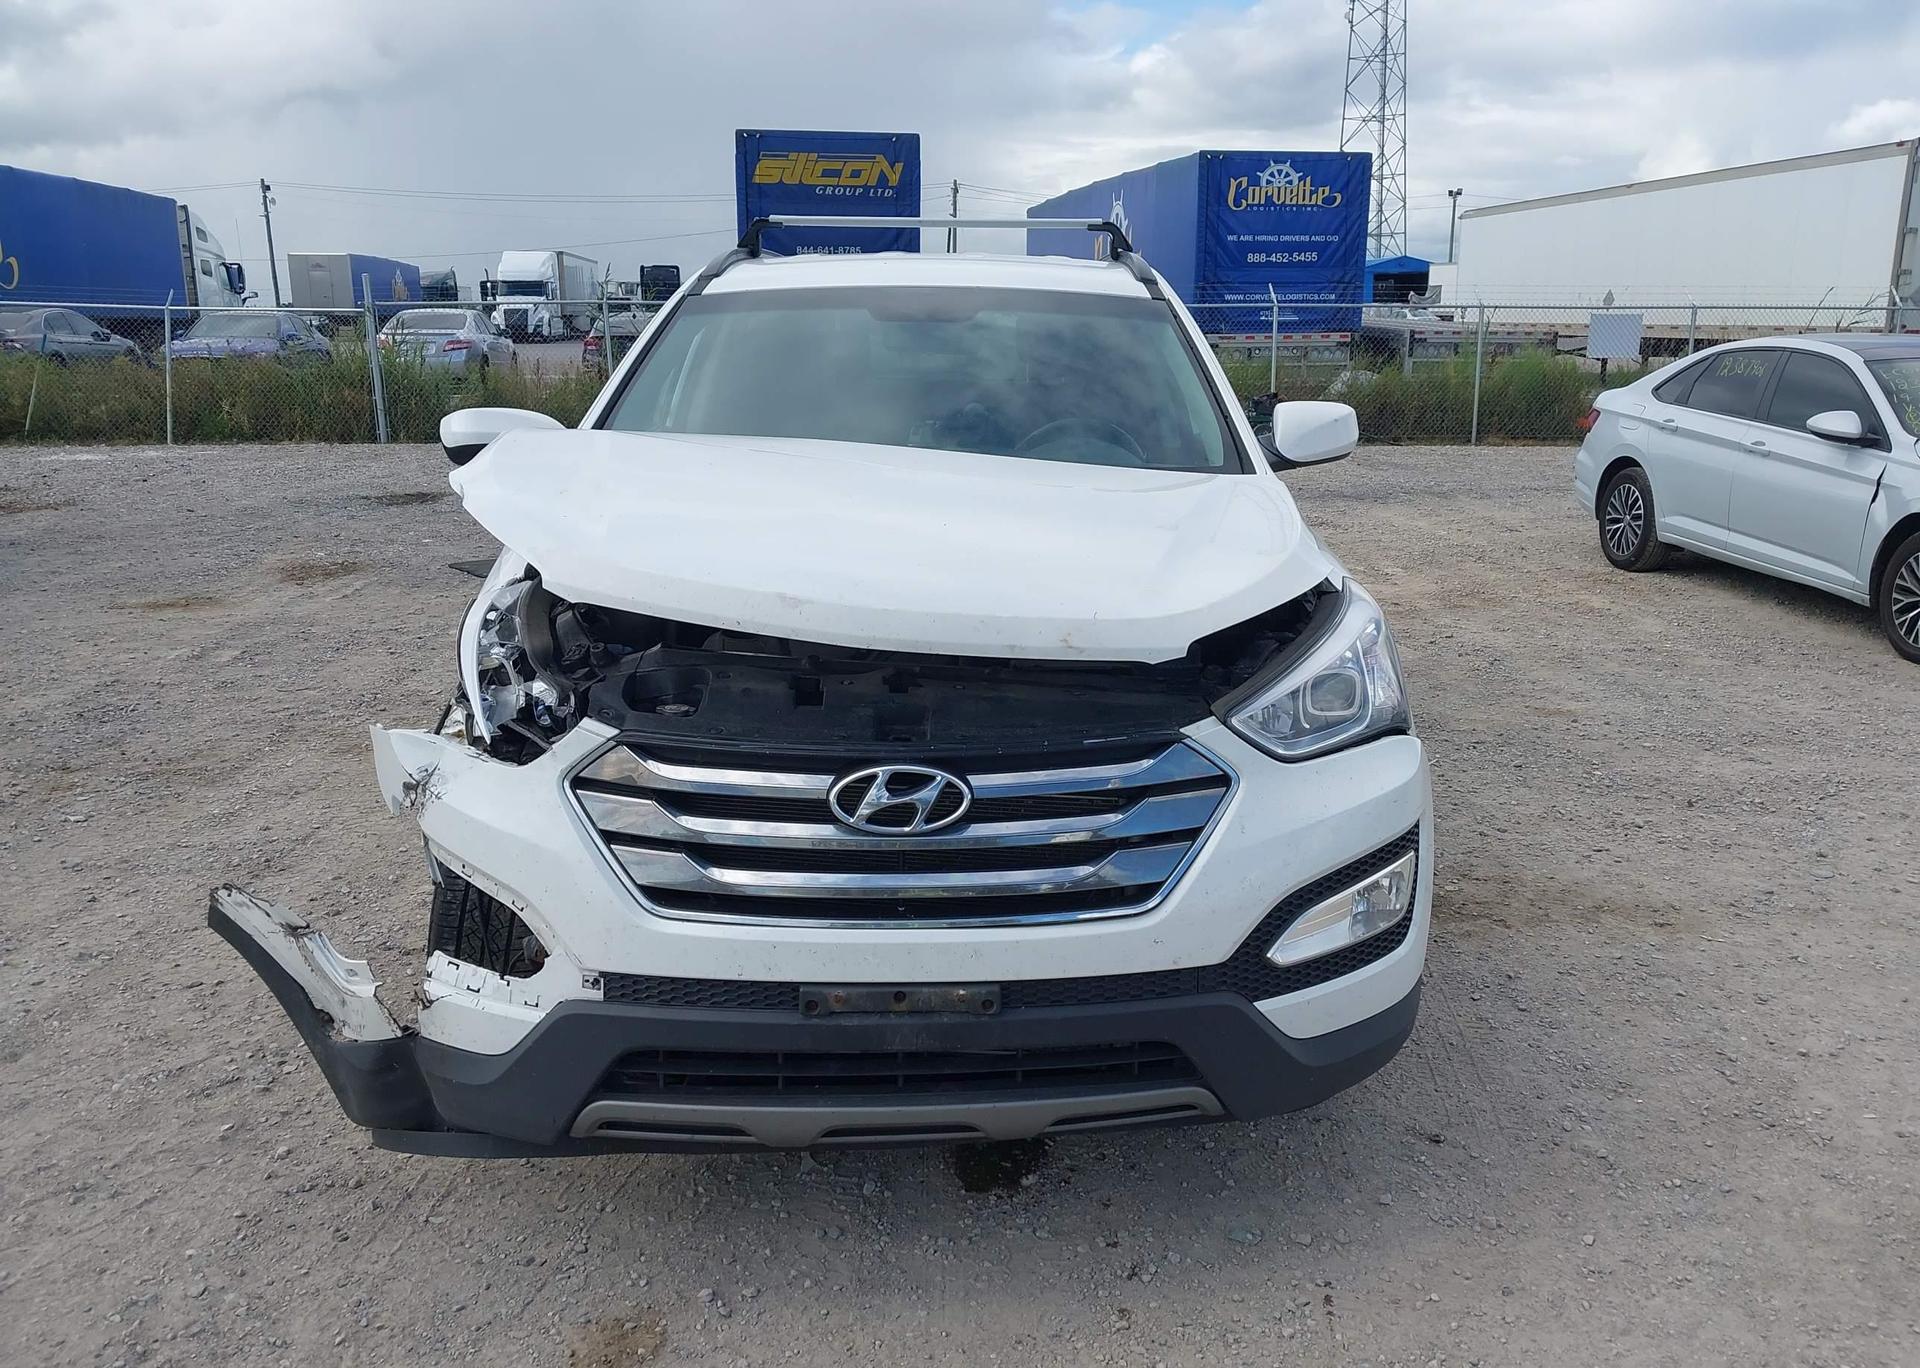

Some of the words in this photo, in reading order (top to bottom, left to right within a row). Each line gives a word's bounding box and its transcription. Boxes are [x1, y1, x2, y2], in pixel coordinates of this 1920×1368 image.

[815, 186, 863, 196] GROUP
[1228, 176, 1342, 211] Corvette
[1239, 234, 1254, 242] ARE
[796, 245, 862, 255] 844-641-8785
[1247, 252, 1318, 263] 888-452-5455
